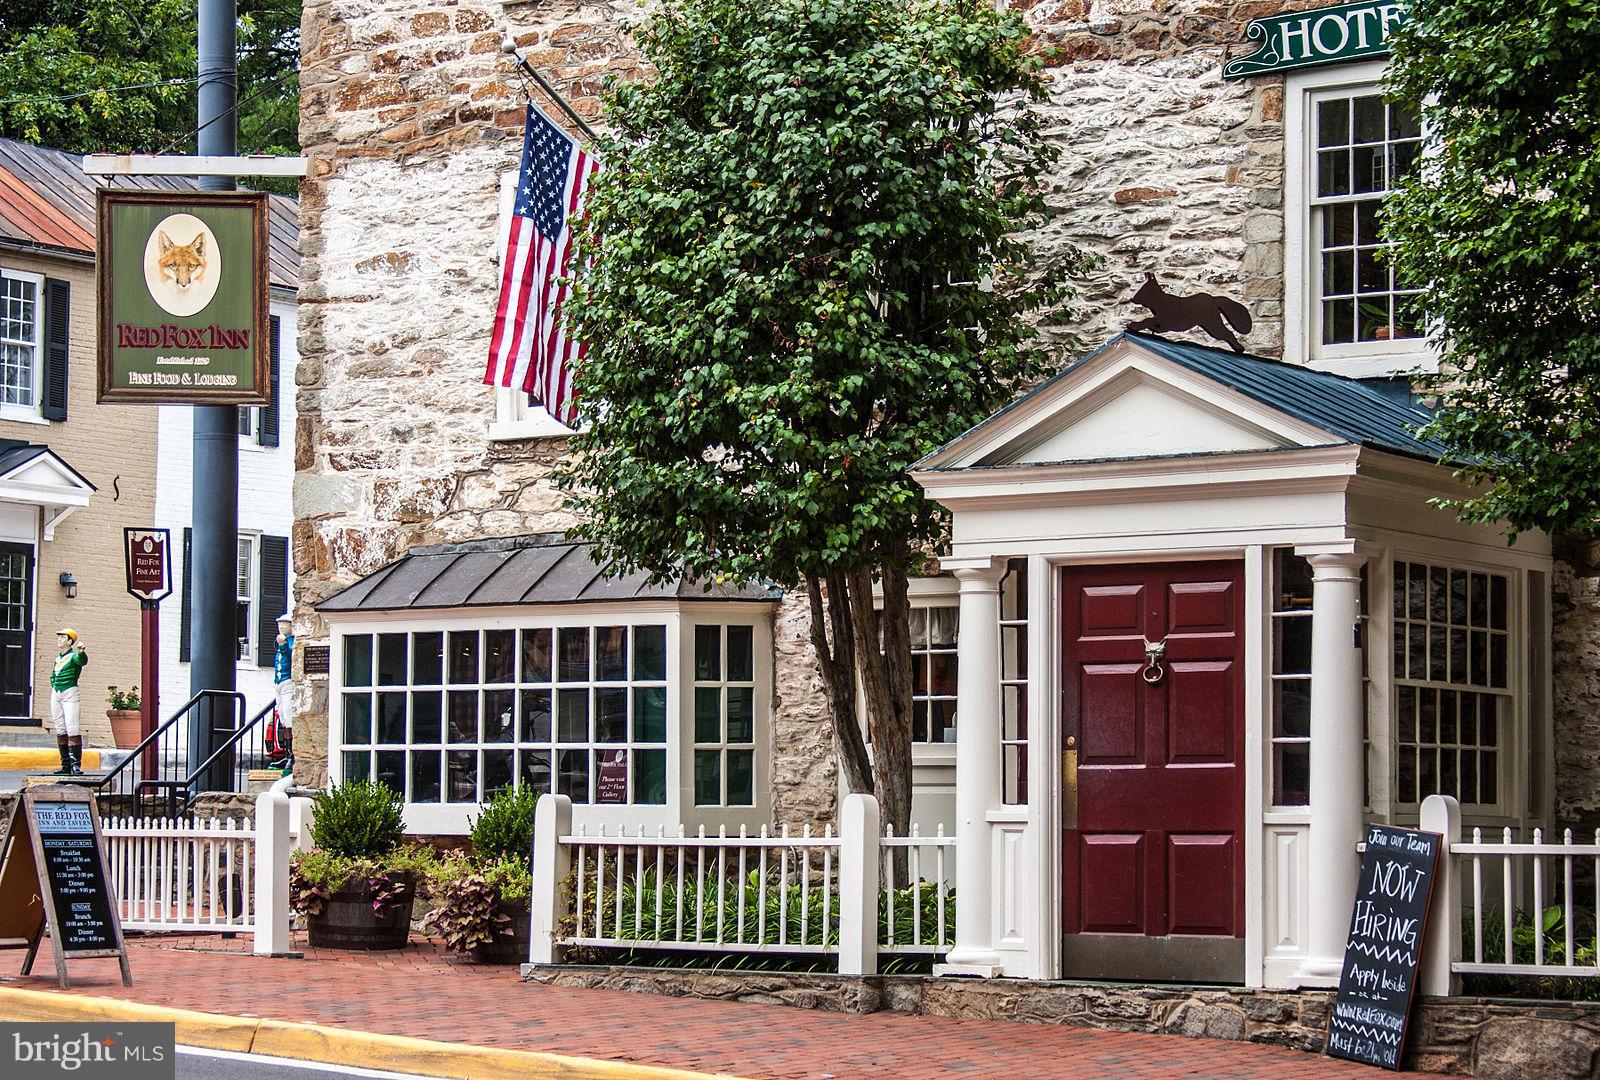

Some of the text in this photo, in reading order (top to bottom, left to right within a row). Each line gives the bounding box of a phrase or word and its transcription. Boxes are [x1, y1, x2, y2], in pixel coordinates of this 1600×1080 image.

[117, 323, 250, 350] RED FOX INN
[128, 372, 238, 386] FINE FOOD & LODGING
[148, 558, 160, 566] FOX
[149, 568, 161, 576] ART
[37, 811, 89, 820] THE RED FOX
[1368, 829, 1431, 856] Join our Team
[1368, 860, 1425, 903] NOW
[1349, 963, 1380, 990] Apply
[1330, 1032, 1353, 1053] Must
